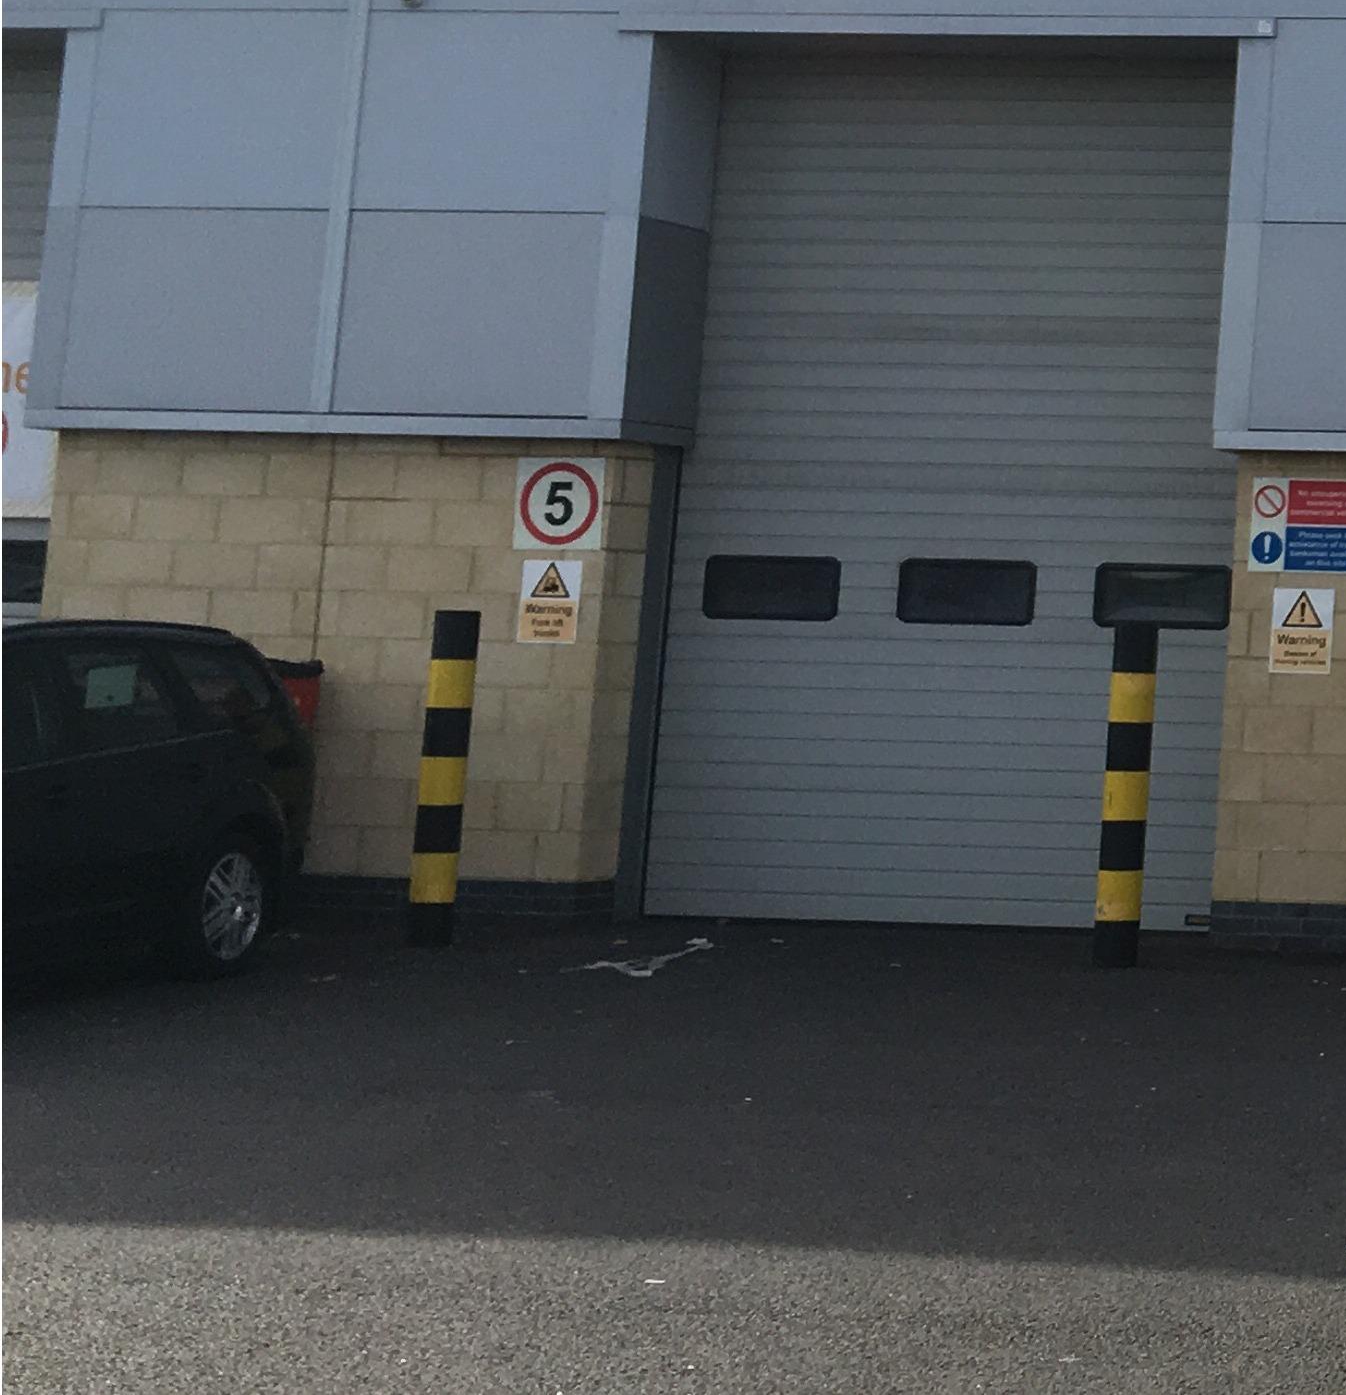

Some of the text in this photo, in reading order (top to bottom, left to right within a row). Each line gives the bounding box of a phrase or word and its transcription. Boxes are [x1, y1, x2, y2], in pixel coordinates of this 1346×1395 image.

[544, 481, 573, 526] 5
[525, 603, 573, 617] Warning
[1277, 633, 1326, 648] Warning
